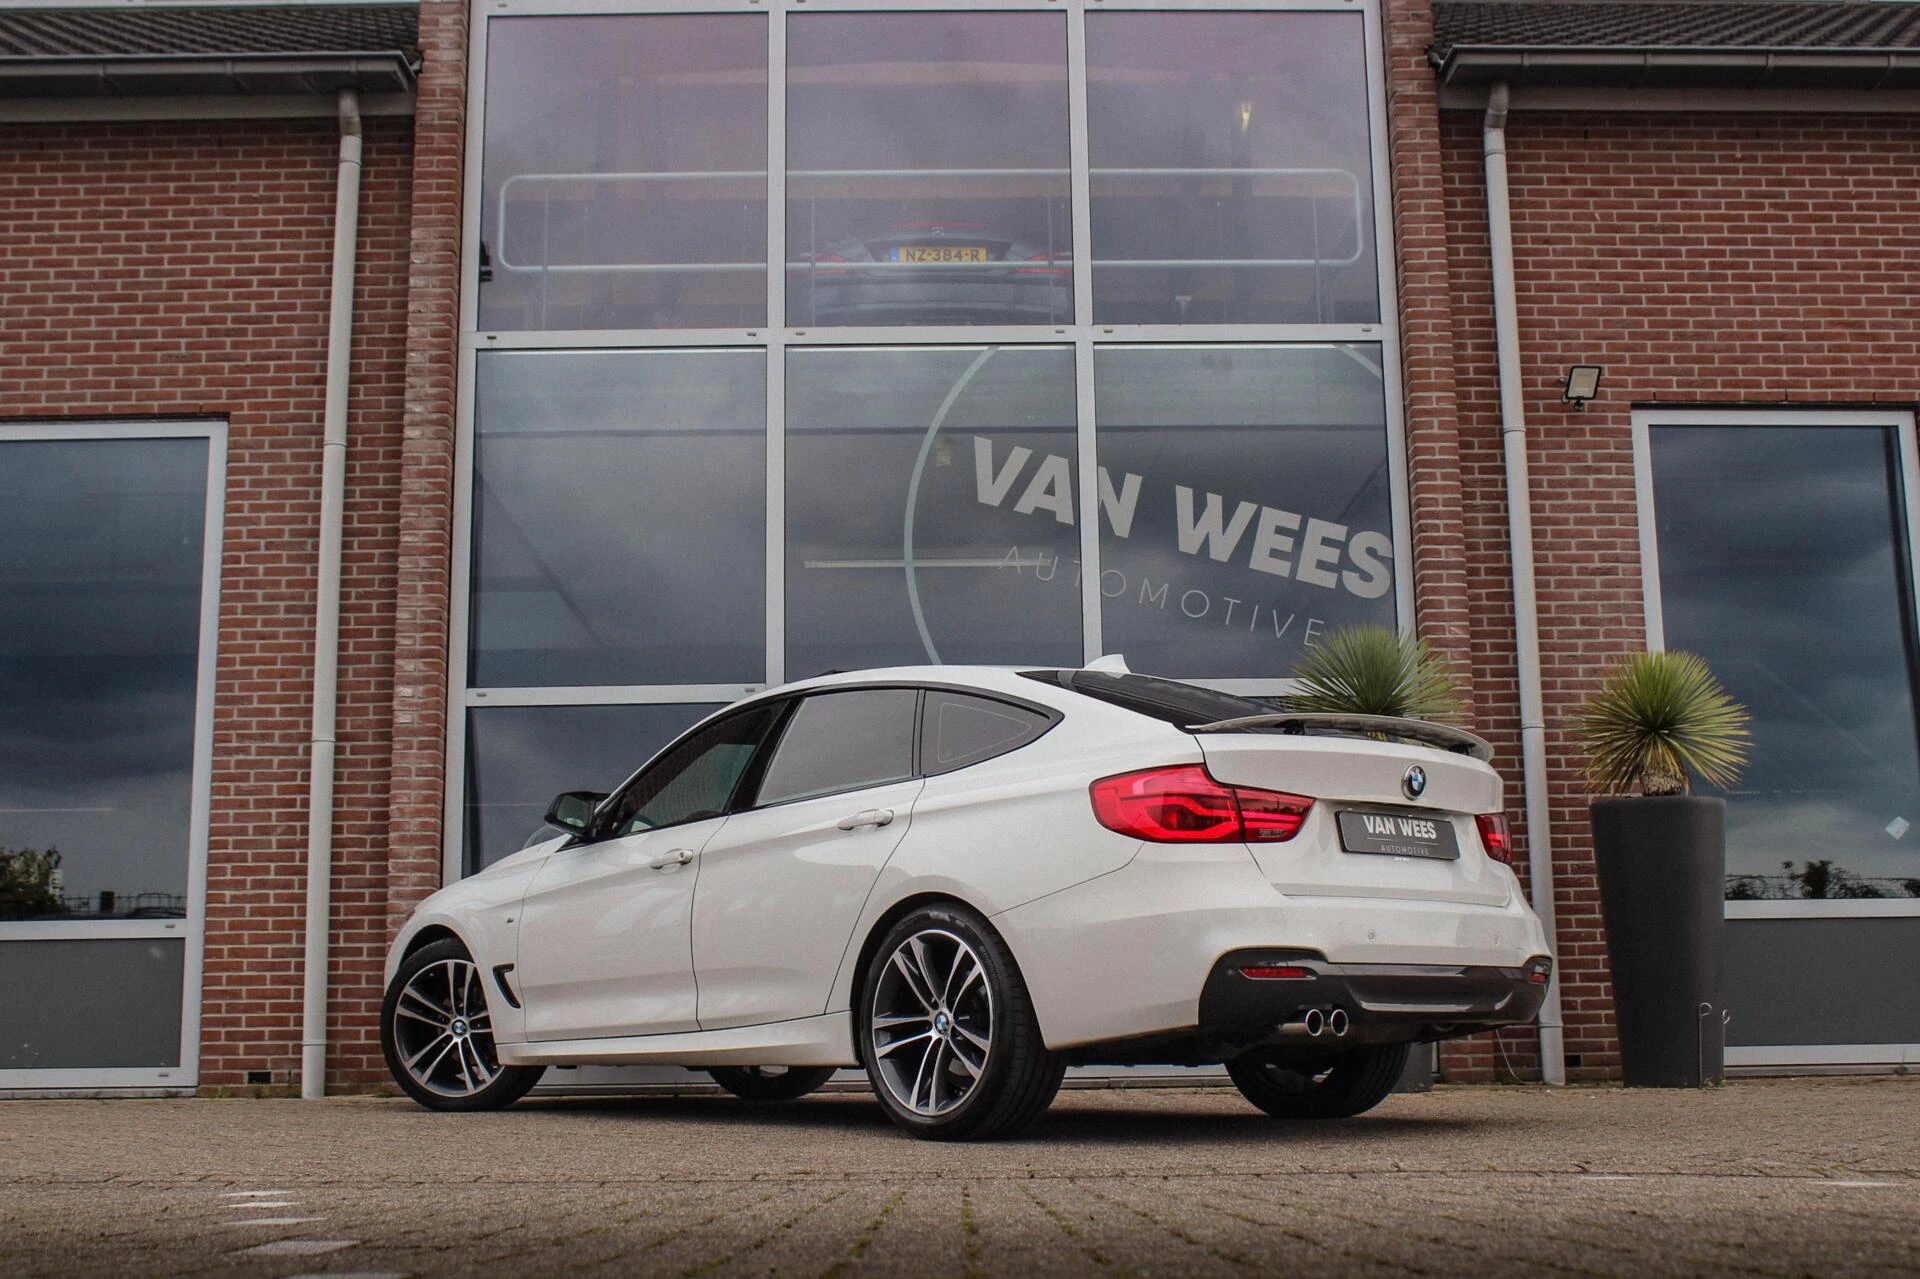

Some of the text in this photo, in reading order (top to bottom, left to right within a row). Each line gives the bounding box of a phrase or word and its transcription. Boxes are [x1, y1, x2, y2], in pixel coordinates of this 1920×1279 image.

[905, 247, 981, 262] NZ-384-R
[974, 435, 1394, 600] VAN WEES
[998, 545, 1325, 647] AUTOMOTIVE
[1363, 815, 1437, 840] VAN WEES
[1381, 843, 1430, 856] AUTOMOTIVE
